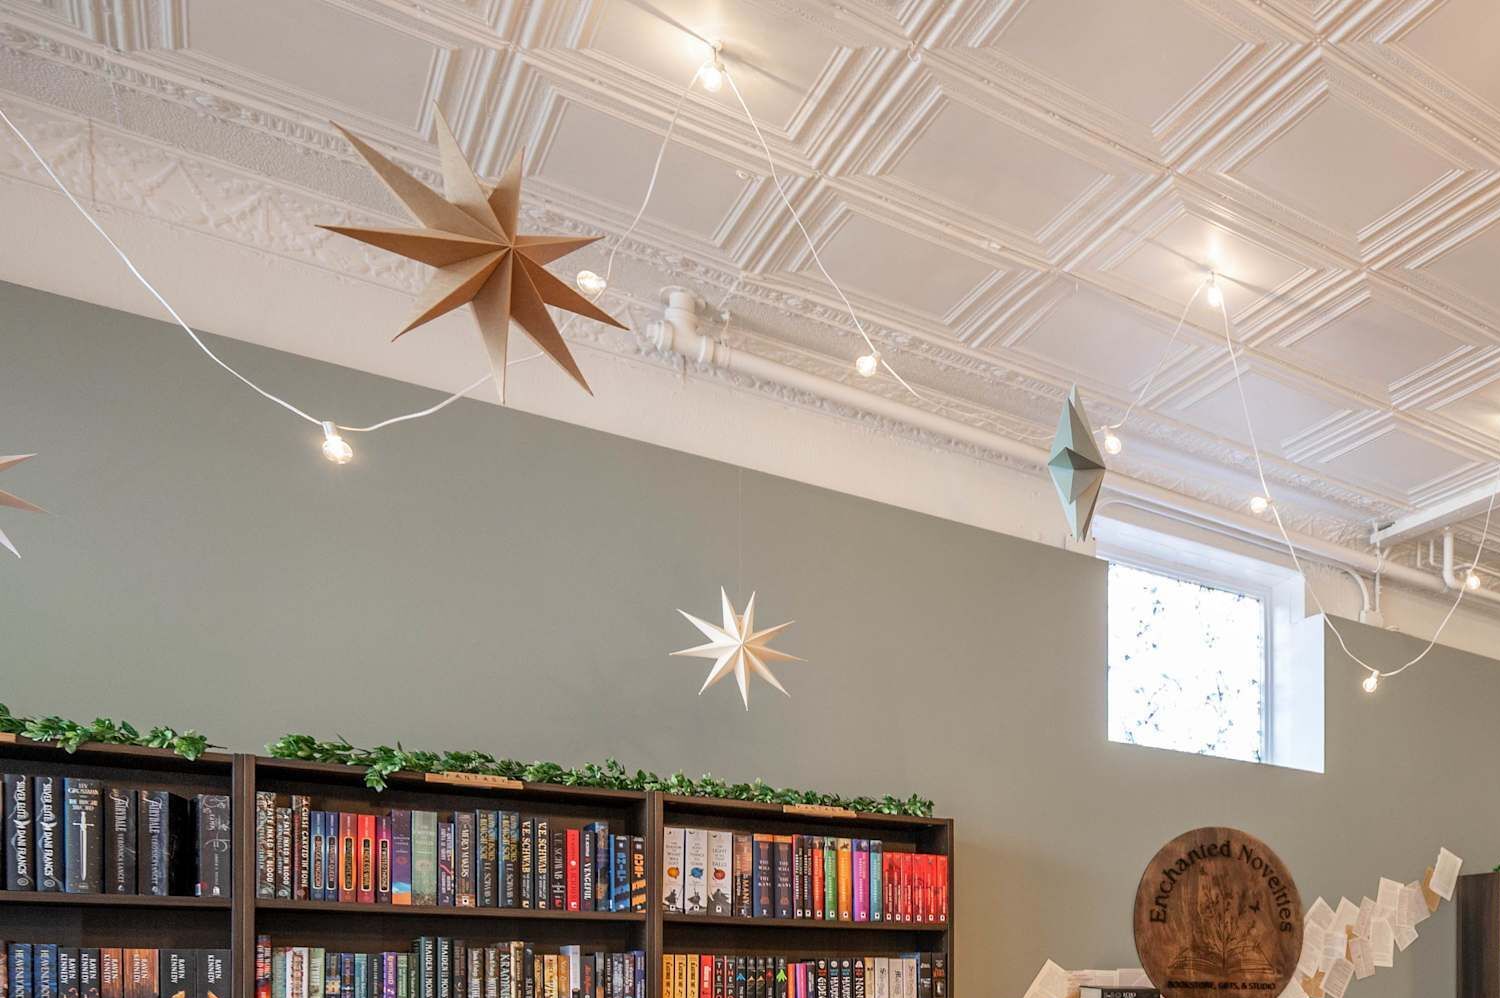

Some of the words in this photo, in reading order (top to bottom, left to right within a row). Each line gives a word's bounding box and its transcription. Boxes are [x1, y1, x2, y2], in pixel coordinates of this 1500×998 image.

[16, 781, 26, 802] SILVER
[43, 783, 53, 804] SILVER
[16, 802, 27, 820] ELITE
[43, 804, 54, 822] ELITE
[114, 797, 129, 833] FAIRYDALE
[148, 798, 163, 834] FAIRYDALE
[17, 829, 26, 846] DANI
[44, 831, 53, 848] DANI
[266, 826, 274, 851] INKED
[538, 823, 547, 836] V.E.
[17, 846, 27, 875] FRANCIS
[44, 848, 54, 876] FRANCIS
[461, 851, 470, 877] MAKERS
[521, 837, 530, 873] SCHWAB
[538, 838, 547, 874] SCHWAB
[554, 847, 562, 879] SCHWAB
[1150, 840, 1232, 924] Enchanted
[1237, 844, 1293, 933] Novelties
[60, 953, 69, 984] KENNEDY
[69, 957, 77, 980] RAVEN
[81, 953, 89, 984] KENNEDY
[103, 953, 111, 984] KENNEDY
[140, 957, 148, 980] RAVEN
[170, 953, 178, 984] KENNEDY
[178, 957, 186, 980] RAVEN
[207, 953, 215, 984] KENNEDY
[425, 944, 433, 970] MAIDEN
[441, 944, 449, 971] MAIDEN
[1240, 981, 1248, 989] &
[1248, 982, 1276, 990] STUDIO
